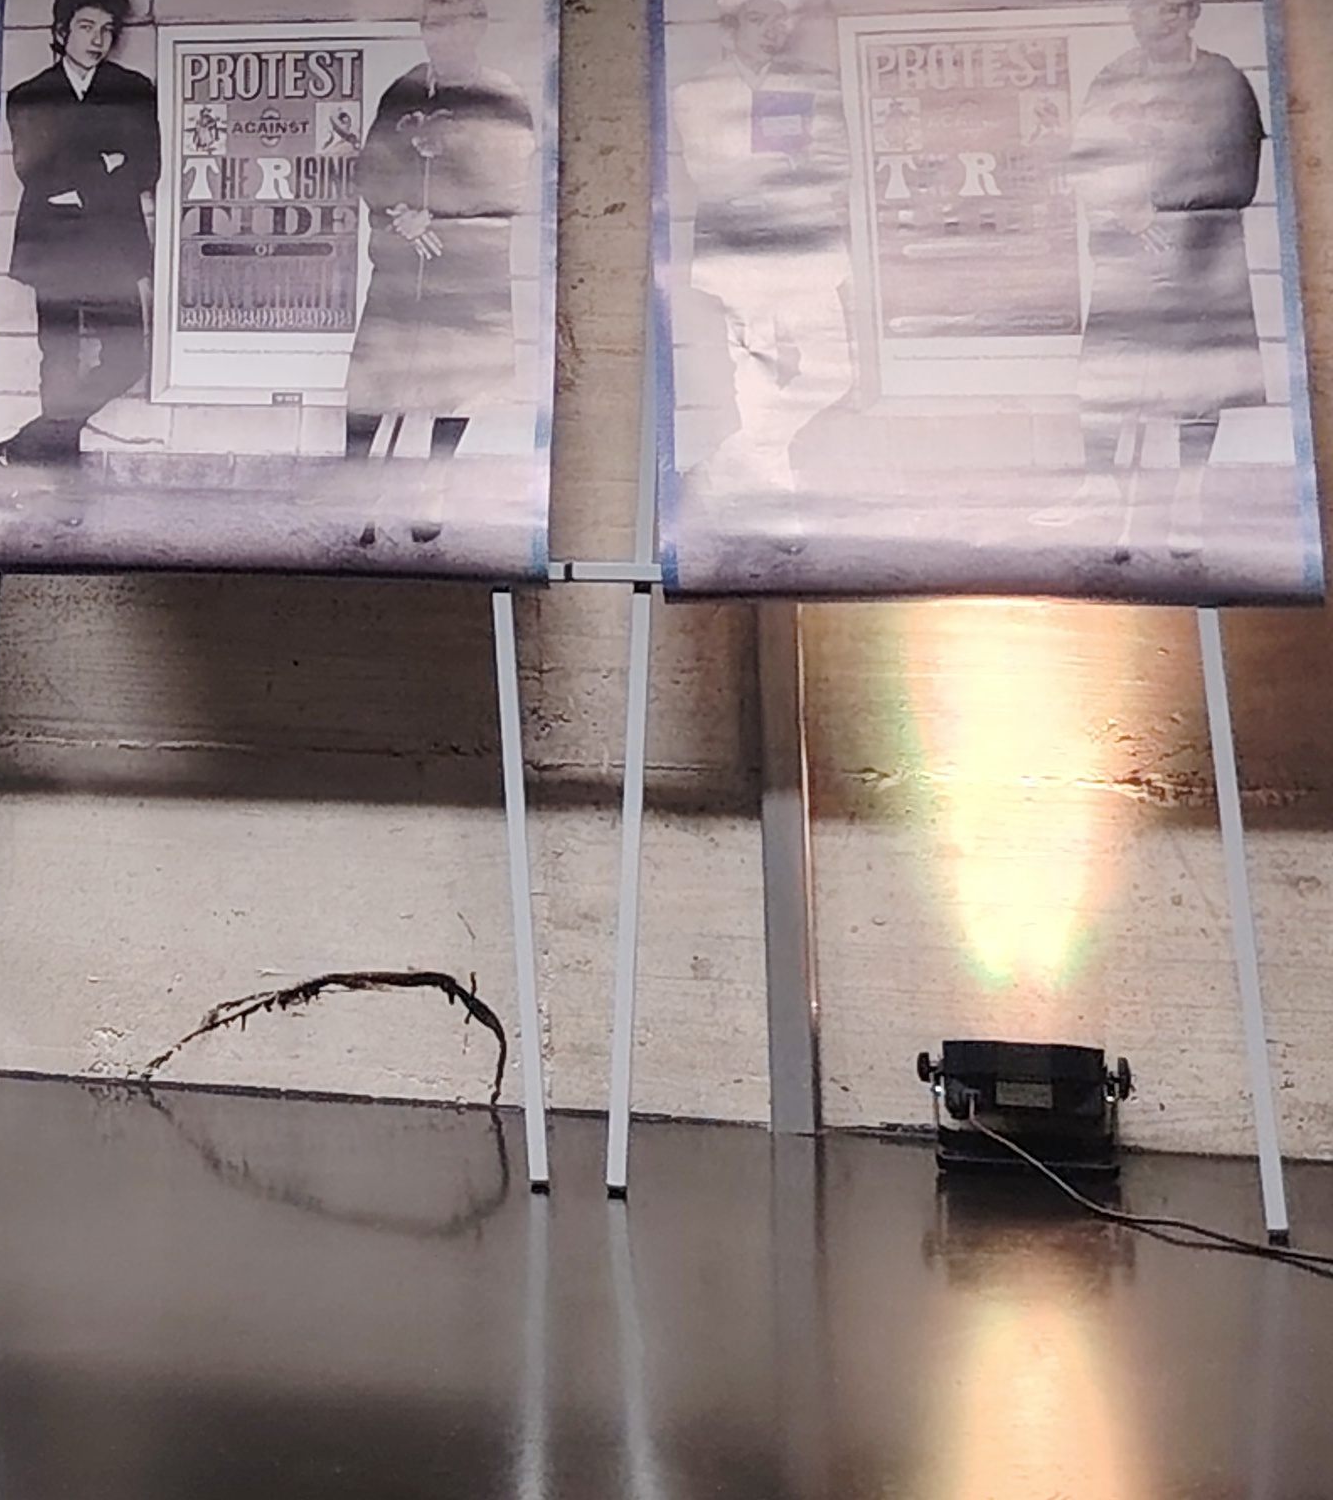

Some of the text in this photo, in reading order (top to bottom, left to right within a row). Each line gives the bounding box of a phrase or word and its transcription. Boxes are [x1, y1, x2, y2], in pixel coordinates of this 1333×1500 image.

[183, 51, 359, 101] PROTEST
[869, 40, 1066, 92] PROTEST
[182, 157, 250, 201] THE
